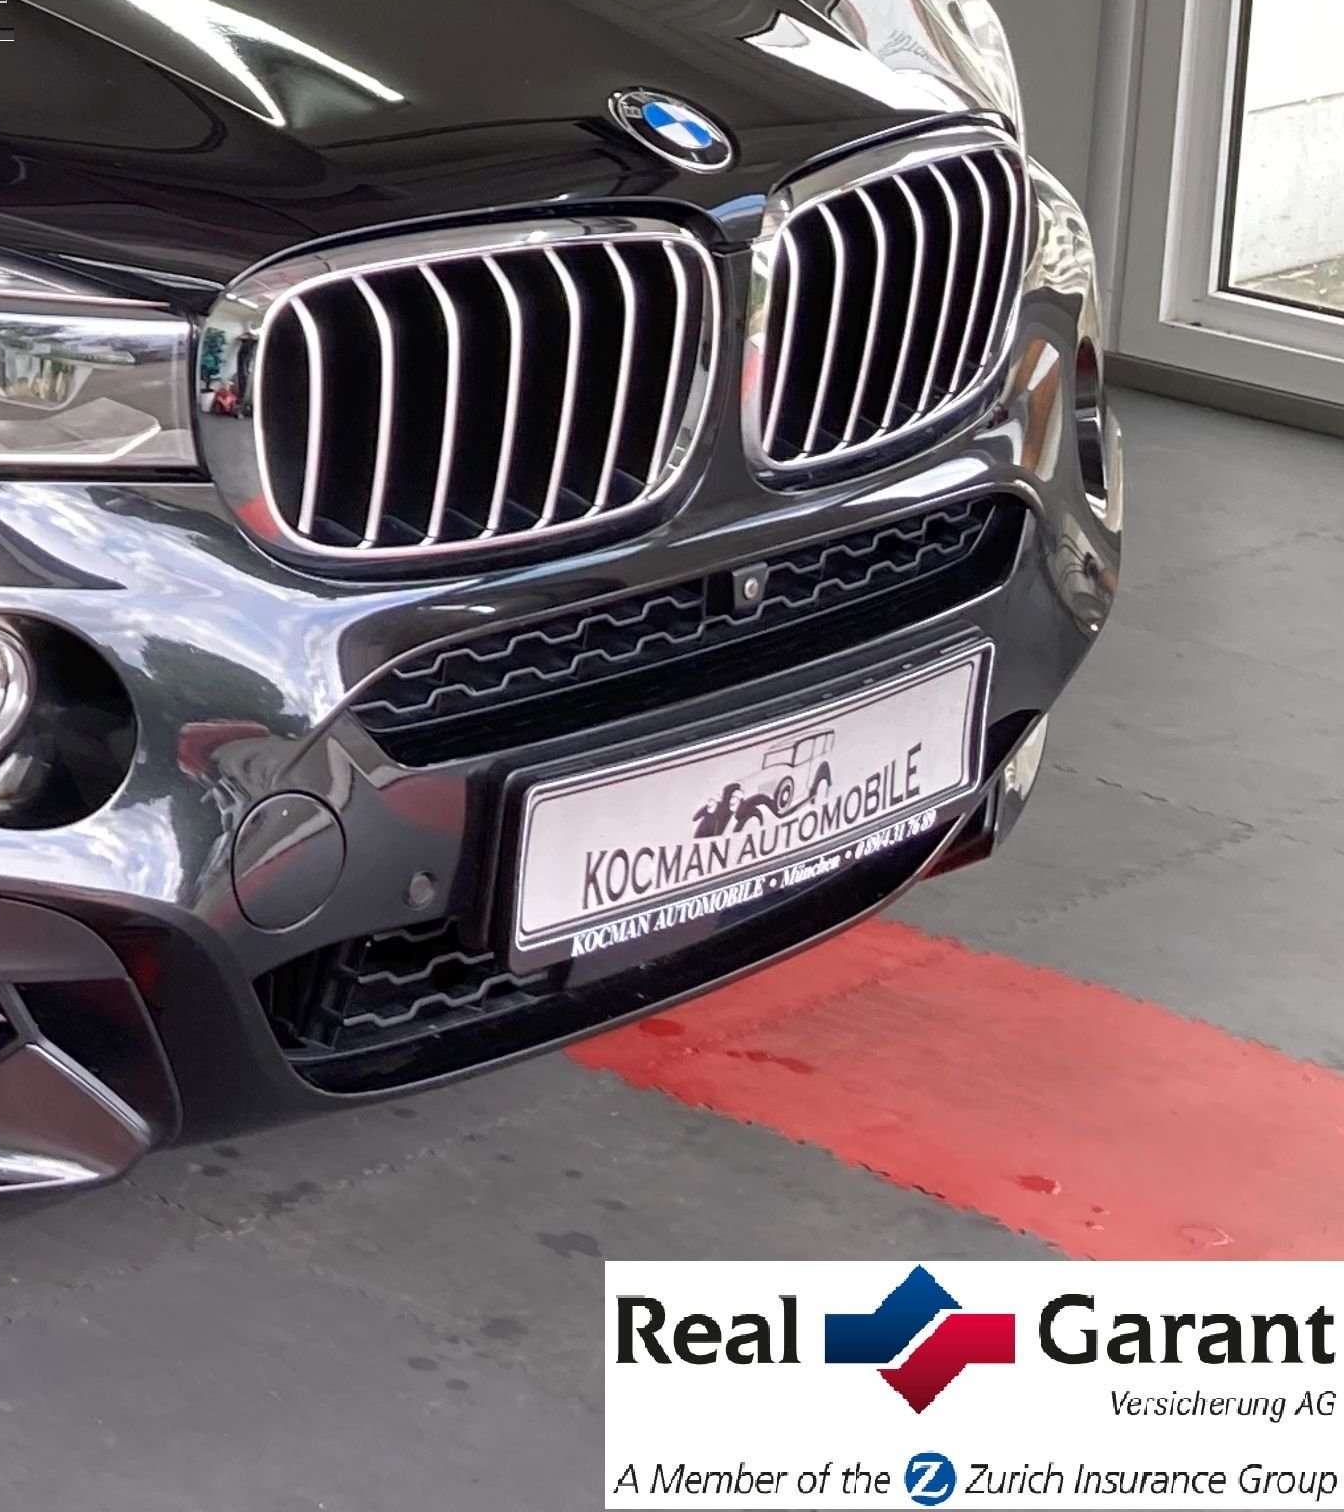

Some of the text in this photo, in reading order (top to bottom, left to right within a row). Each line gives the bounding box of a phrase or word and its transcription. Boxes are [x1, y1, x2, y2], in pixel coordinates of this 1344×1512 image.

[582, 742, 923, 910] KOCMAN AUTOMOBILE
[570, 912, 652, 957] KOCMAN
[653, 875, 765, 931] AUTOMOBILE
[781, 854, 841, 888] München
